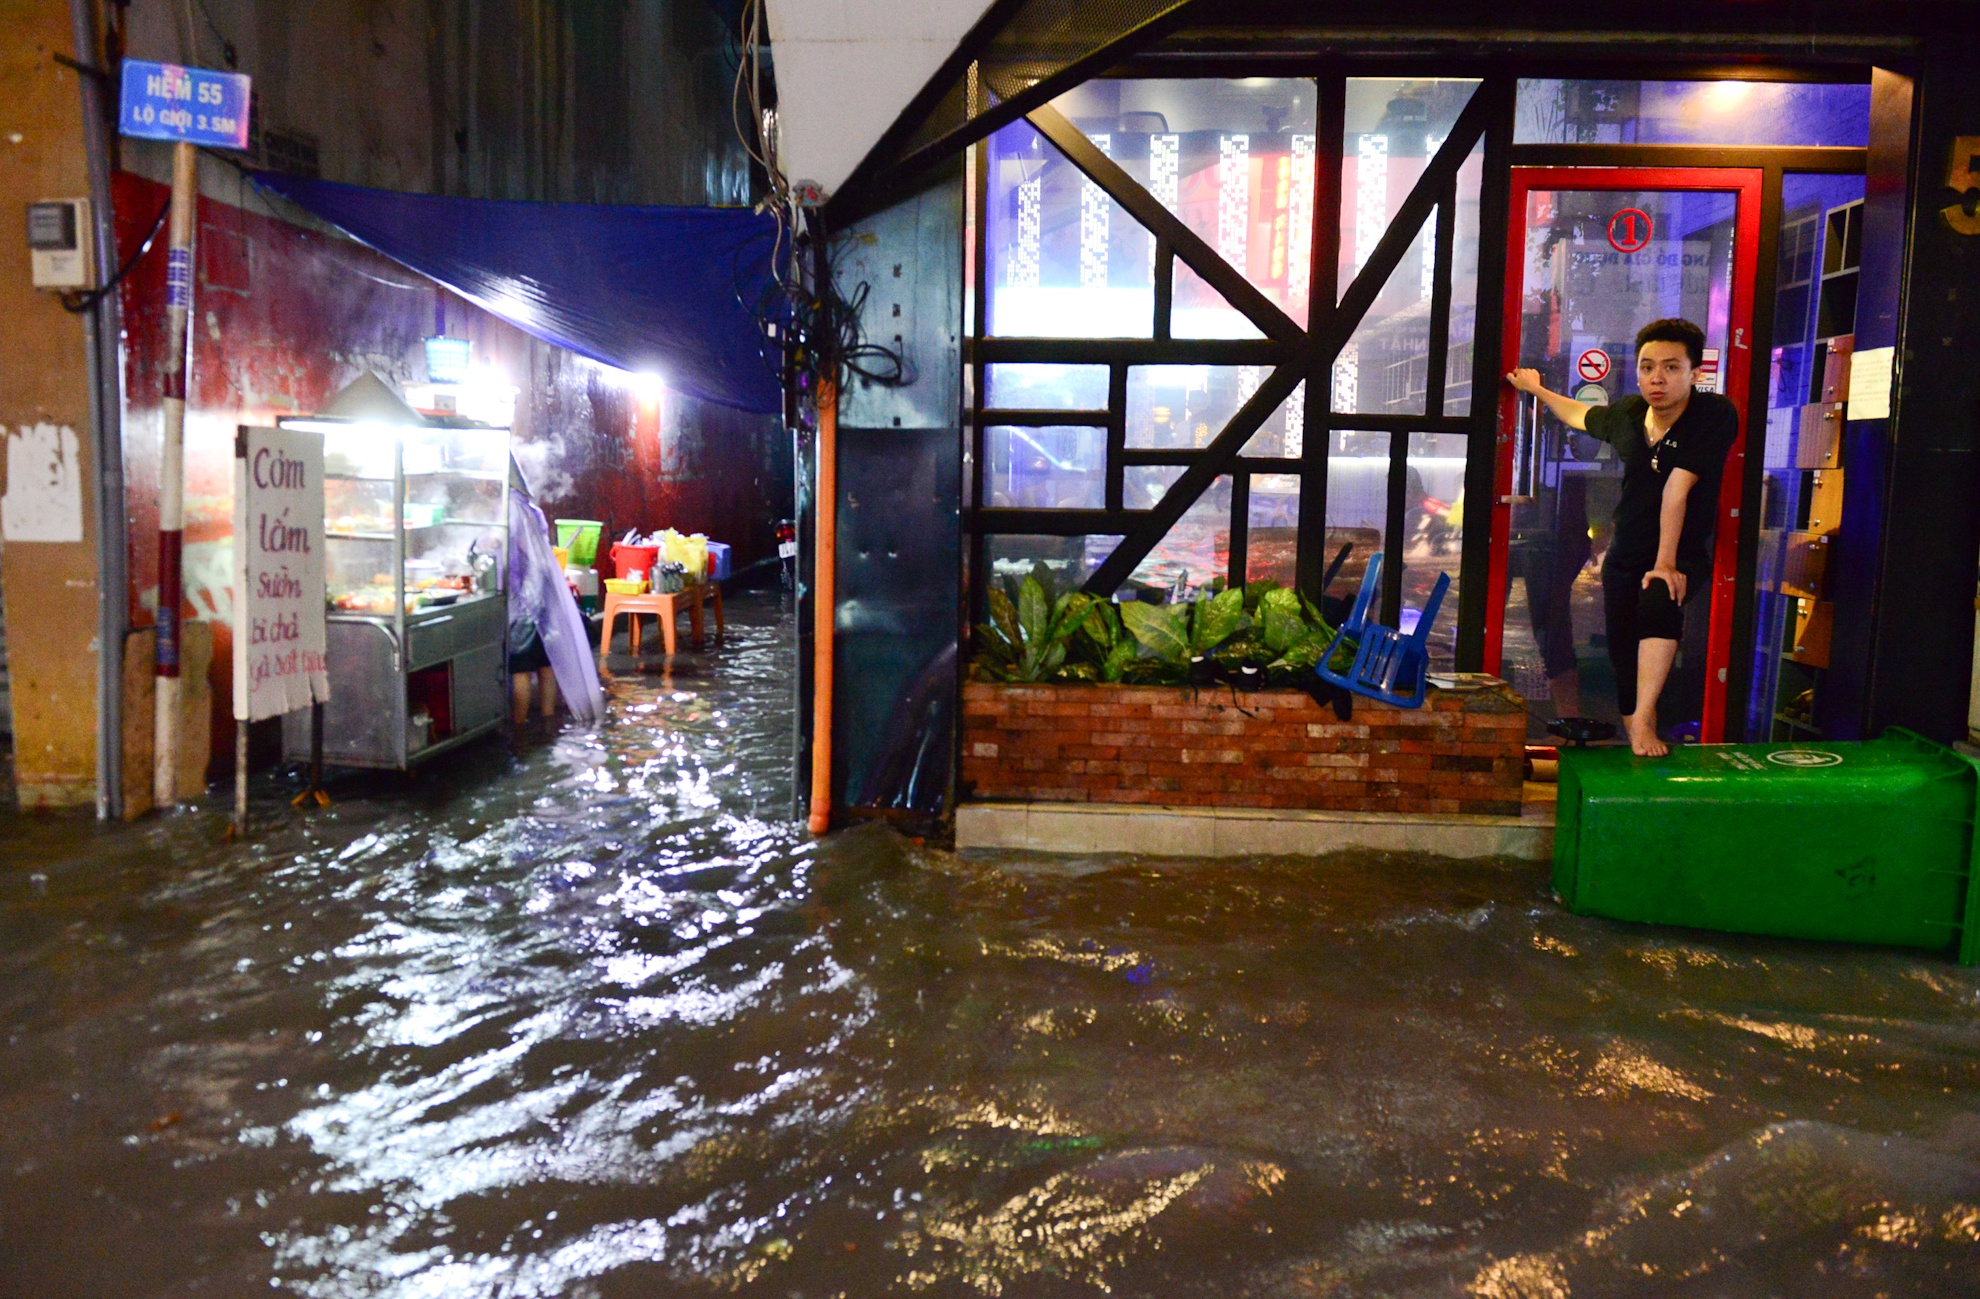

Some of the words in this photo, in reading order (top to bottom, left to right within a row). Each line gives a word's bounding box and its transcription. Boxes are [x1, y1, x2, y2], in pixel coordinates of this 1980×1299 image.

[197, 82, 223, 105] 55
[133, 103, 155, 125] LỘ
[197, 114, 237, 134] 3.5M
